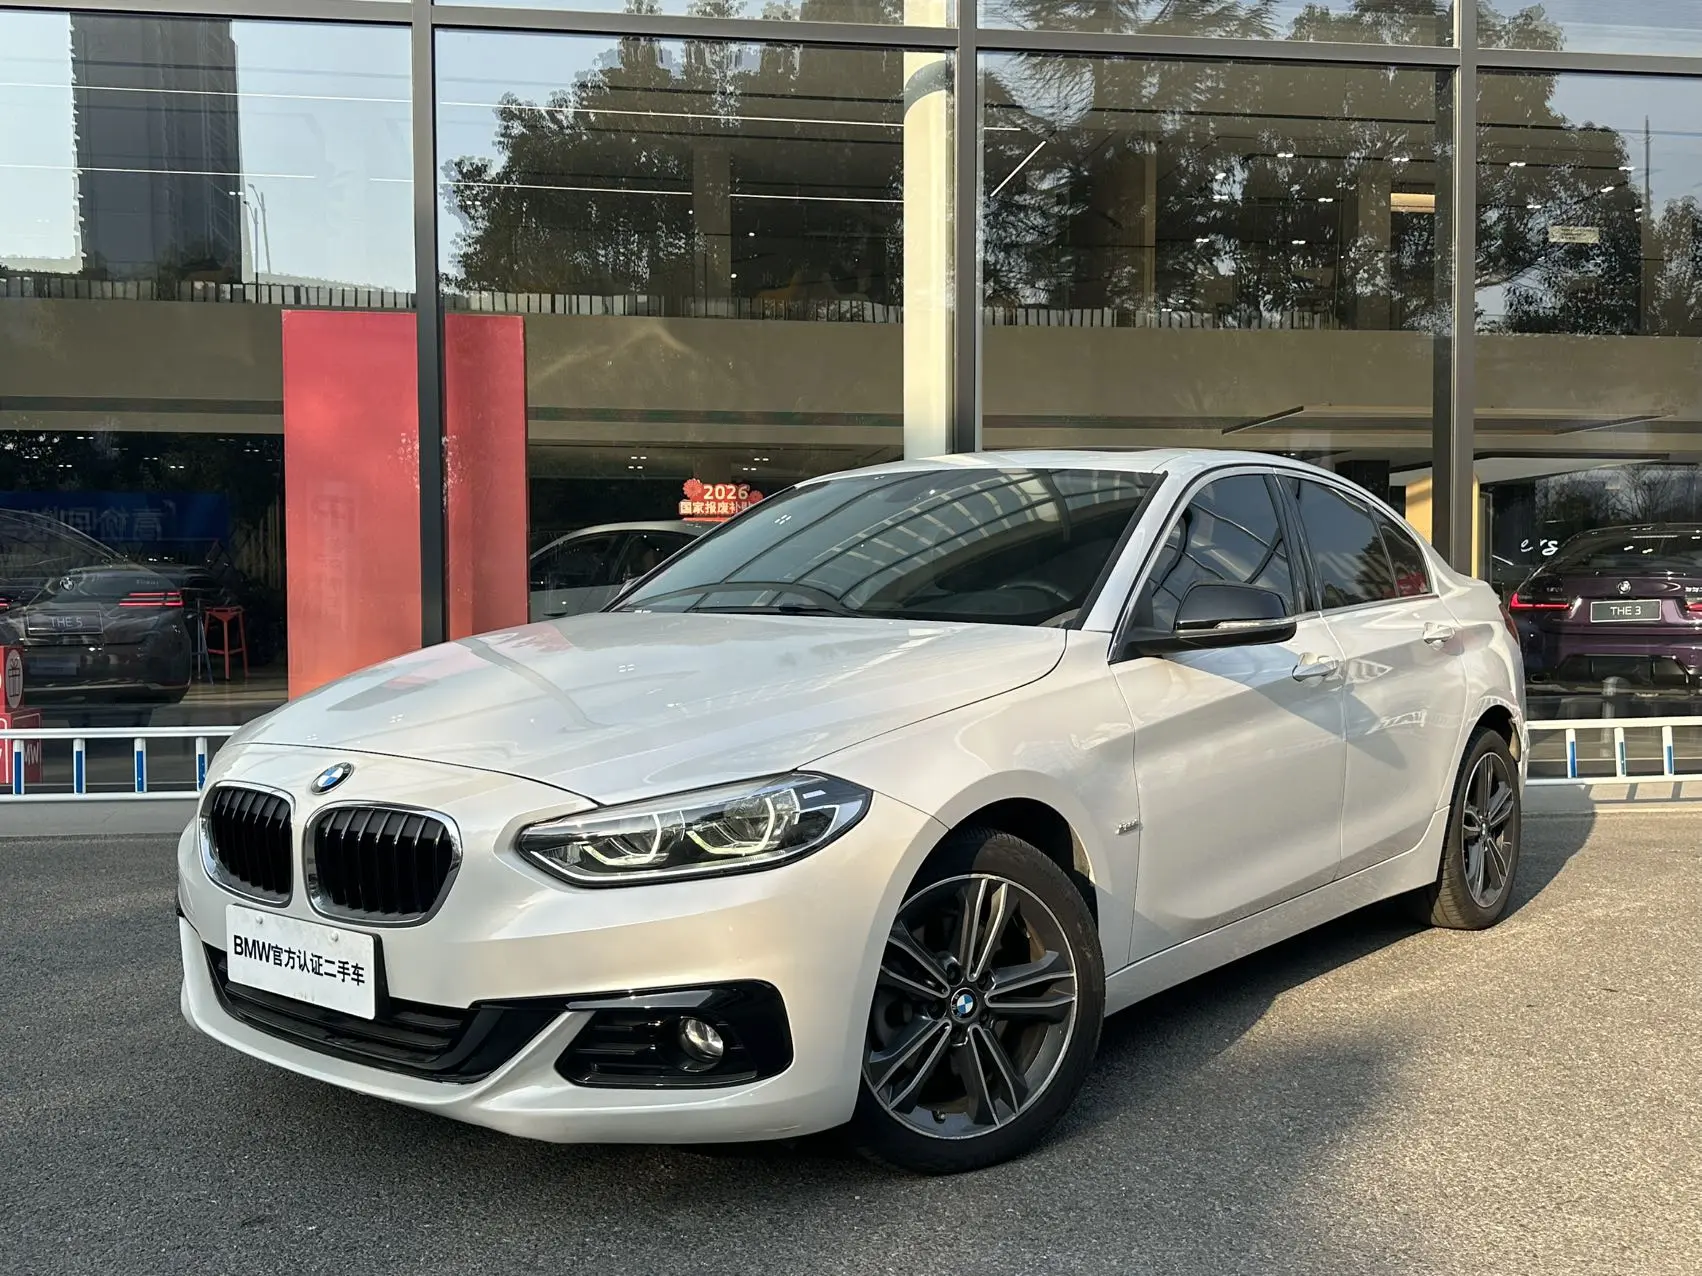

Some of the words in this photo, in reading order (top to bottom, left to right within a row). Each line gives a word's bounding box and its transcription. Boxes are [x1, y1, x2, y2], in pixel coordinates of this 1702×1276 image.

[703, 485, 749, 500] 2026
[1609, 606, 1632, 616] THE
[1634, 605, 1642, 616] 3
[51, 616, 73, 628] THE
[76, 616, 83, 628] 5
[233, 934, 366, 987] BMW官方认证二手车
